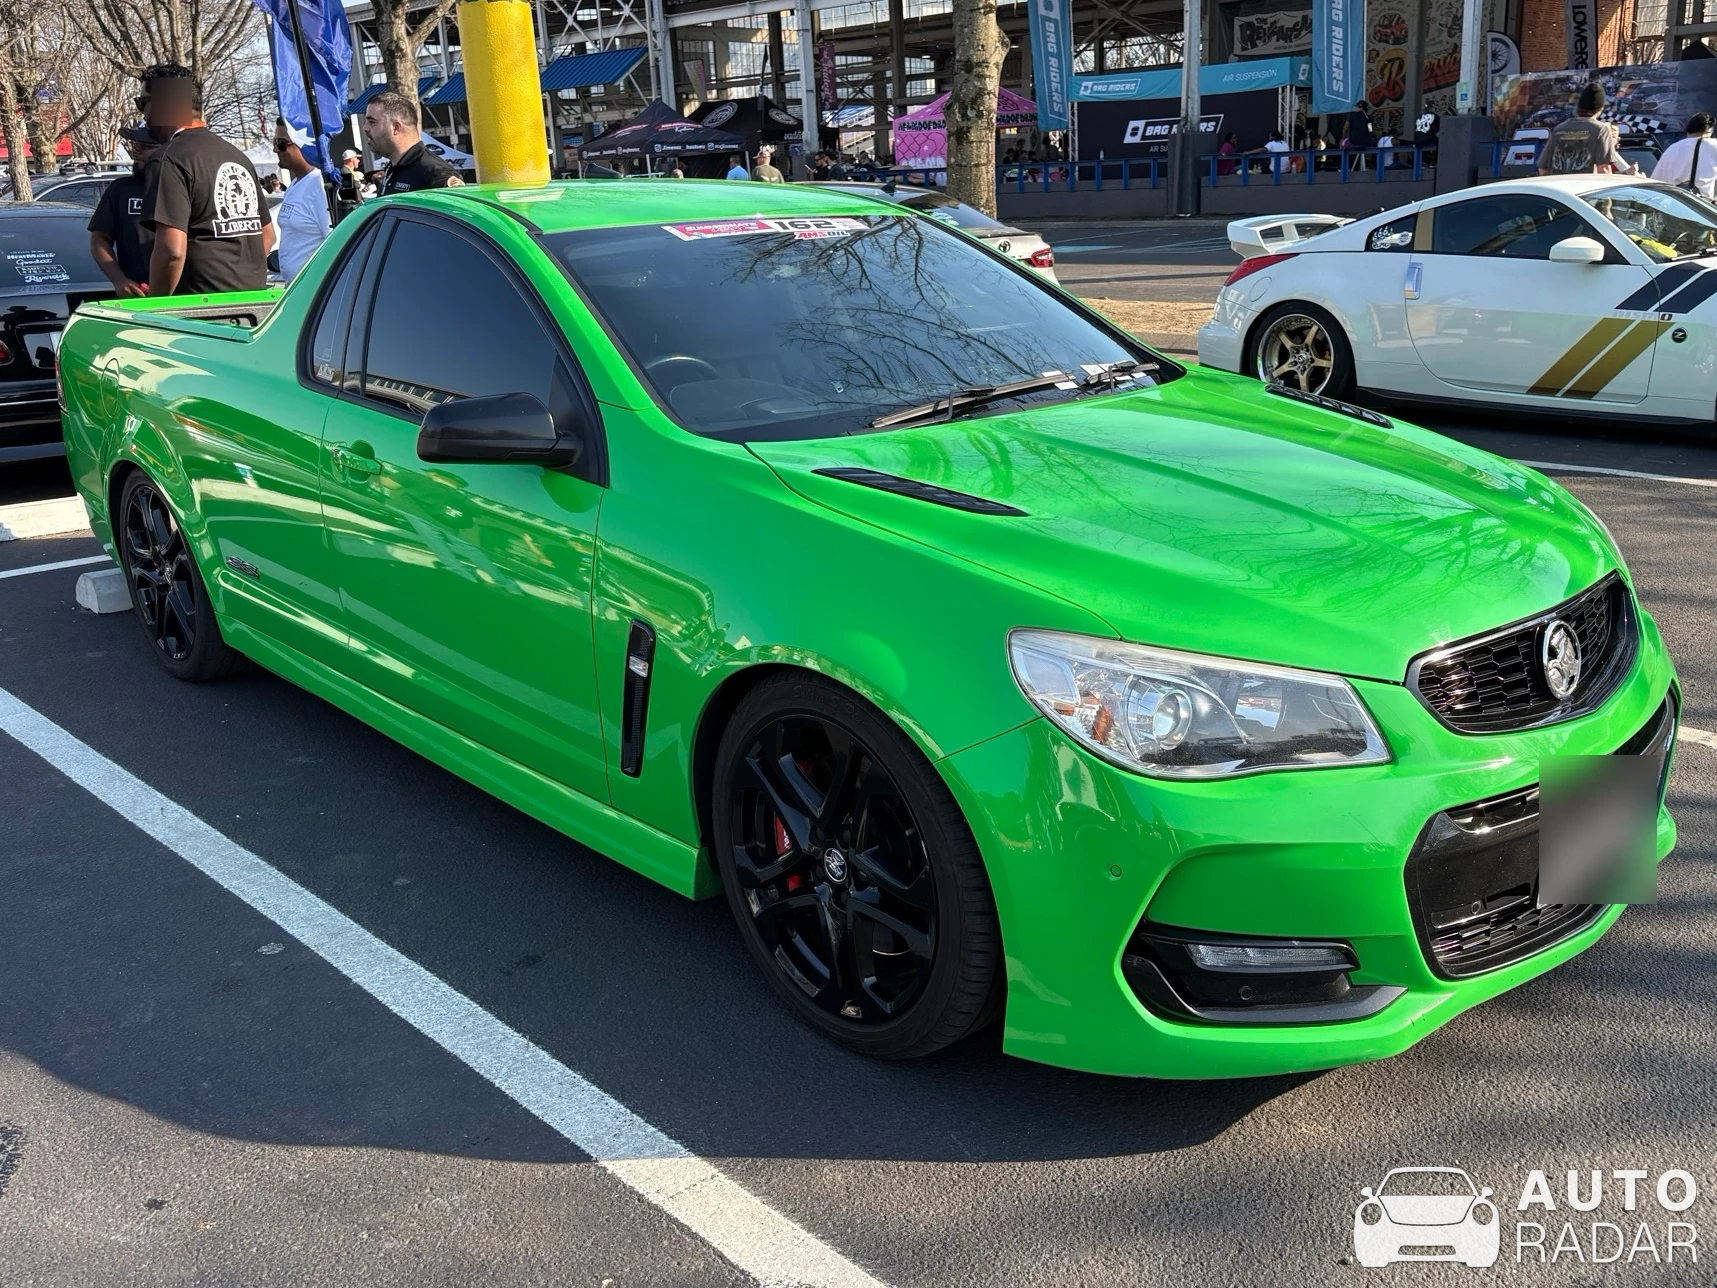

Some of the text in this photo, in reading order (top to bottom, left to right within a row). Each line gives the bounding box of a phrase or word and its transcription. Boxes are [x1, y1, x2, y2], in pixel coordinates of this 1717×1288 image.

[1331, 0, 1344, 93] AG RIDERS
[1045, 20, 1063, 114] BAG RIDERS
[1222, 69, 1278, 82] AIR SUSPENSION
[1092, 82, 1136, 92] BAG RIDERS
[1145, 124, 1170, 136] BAG
[775, 220, 836, 230] 162
[797, 231, 850, 240] AMSOIL
